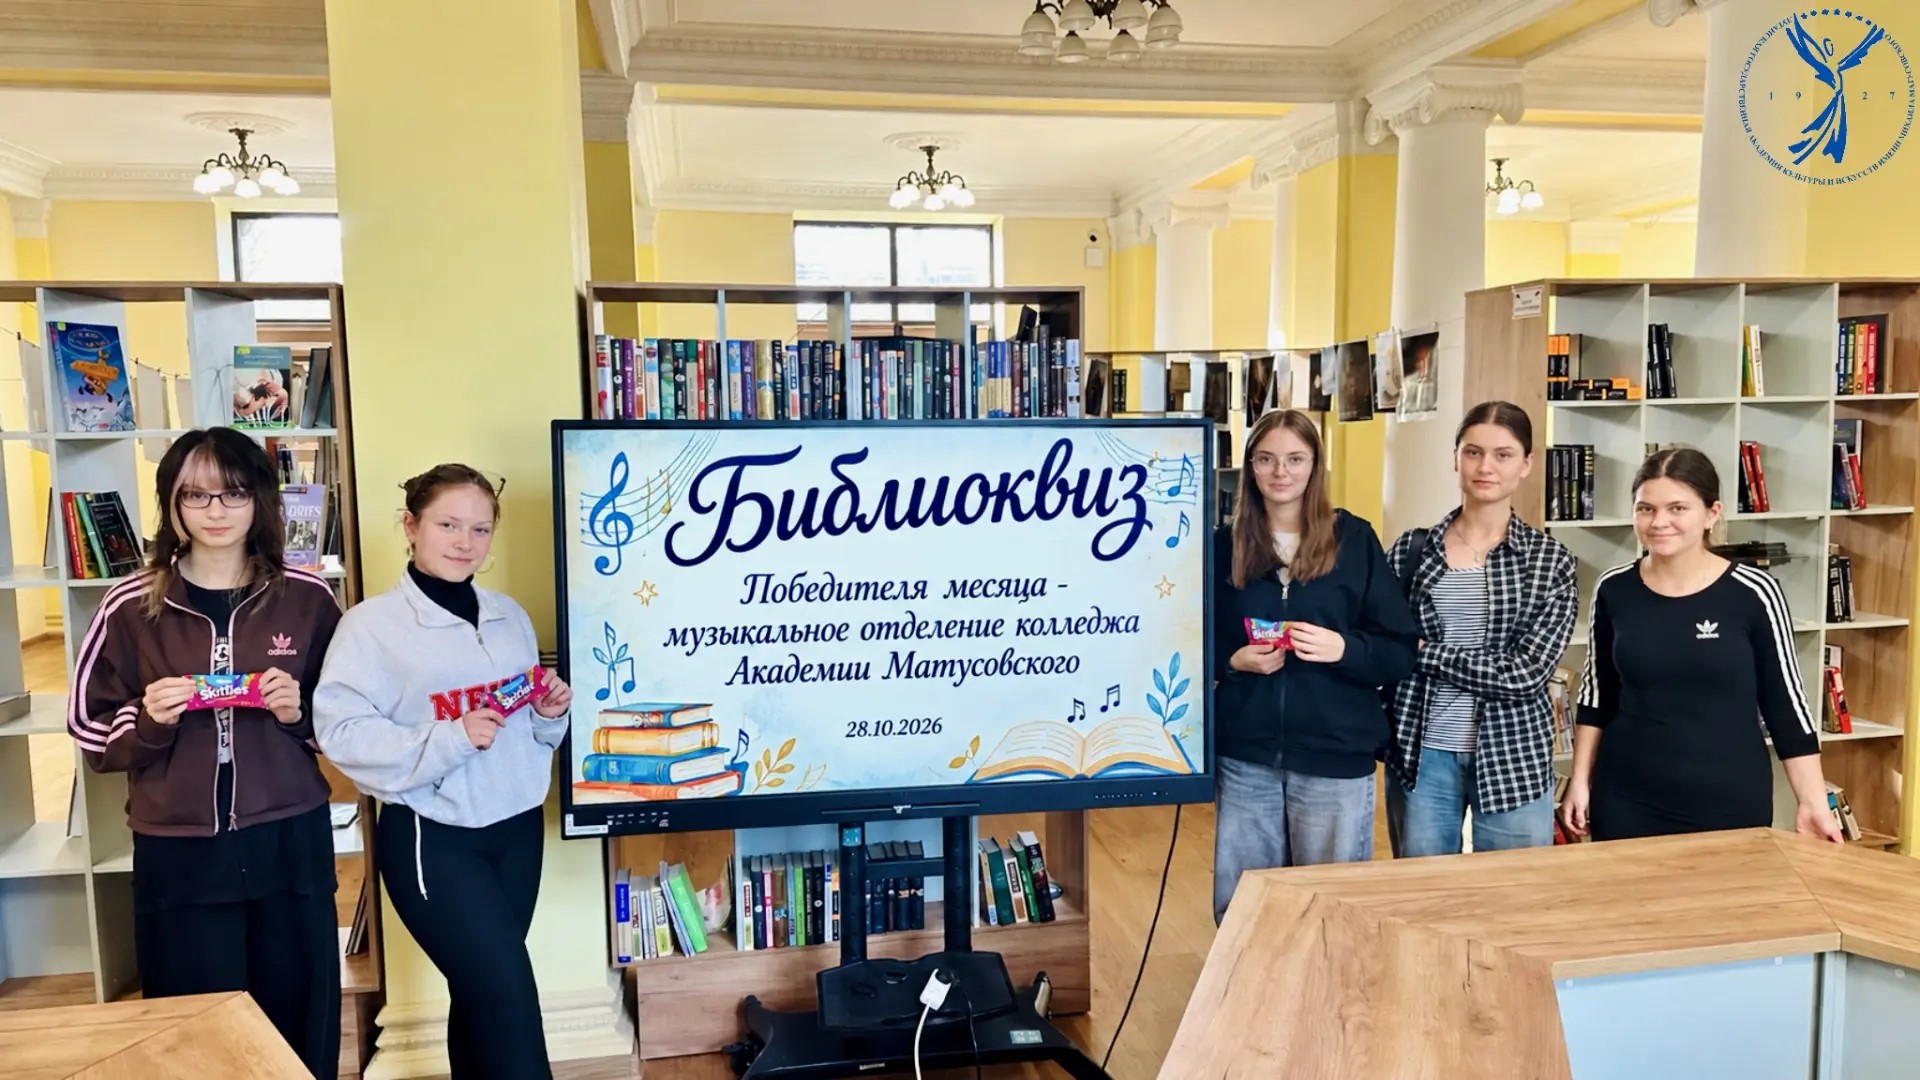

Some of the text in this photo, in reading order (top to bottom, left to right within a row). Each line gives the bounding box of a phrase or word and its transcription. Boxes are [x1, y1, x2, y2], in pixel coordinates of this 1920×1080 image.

[664, 438, 1153, 567] Библиоквиз
[740, 571, 928, 604] Победителя
[943, 577, 1047, 604] месяца
[663, 606, 1140, 656] музыкальное отделение колледжа
[725, 647, 1080, 687] Академии Матусовского
[199, 684, 249, 701] Skittles
[845, 717, 942, 738] 28.10.2026
